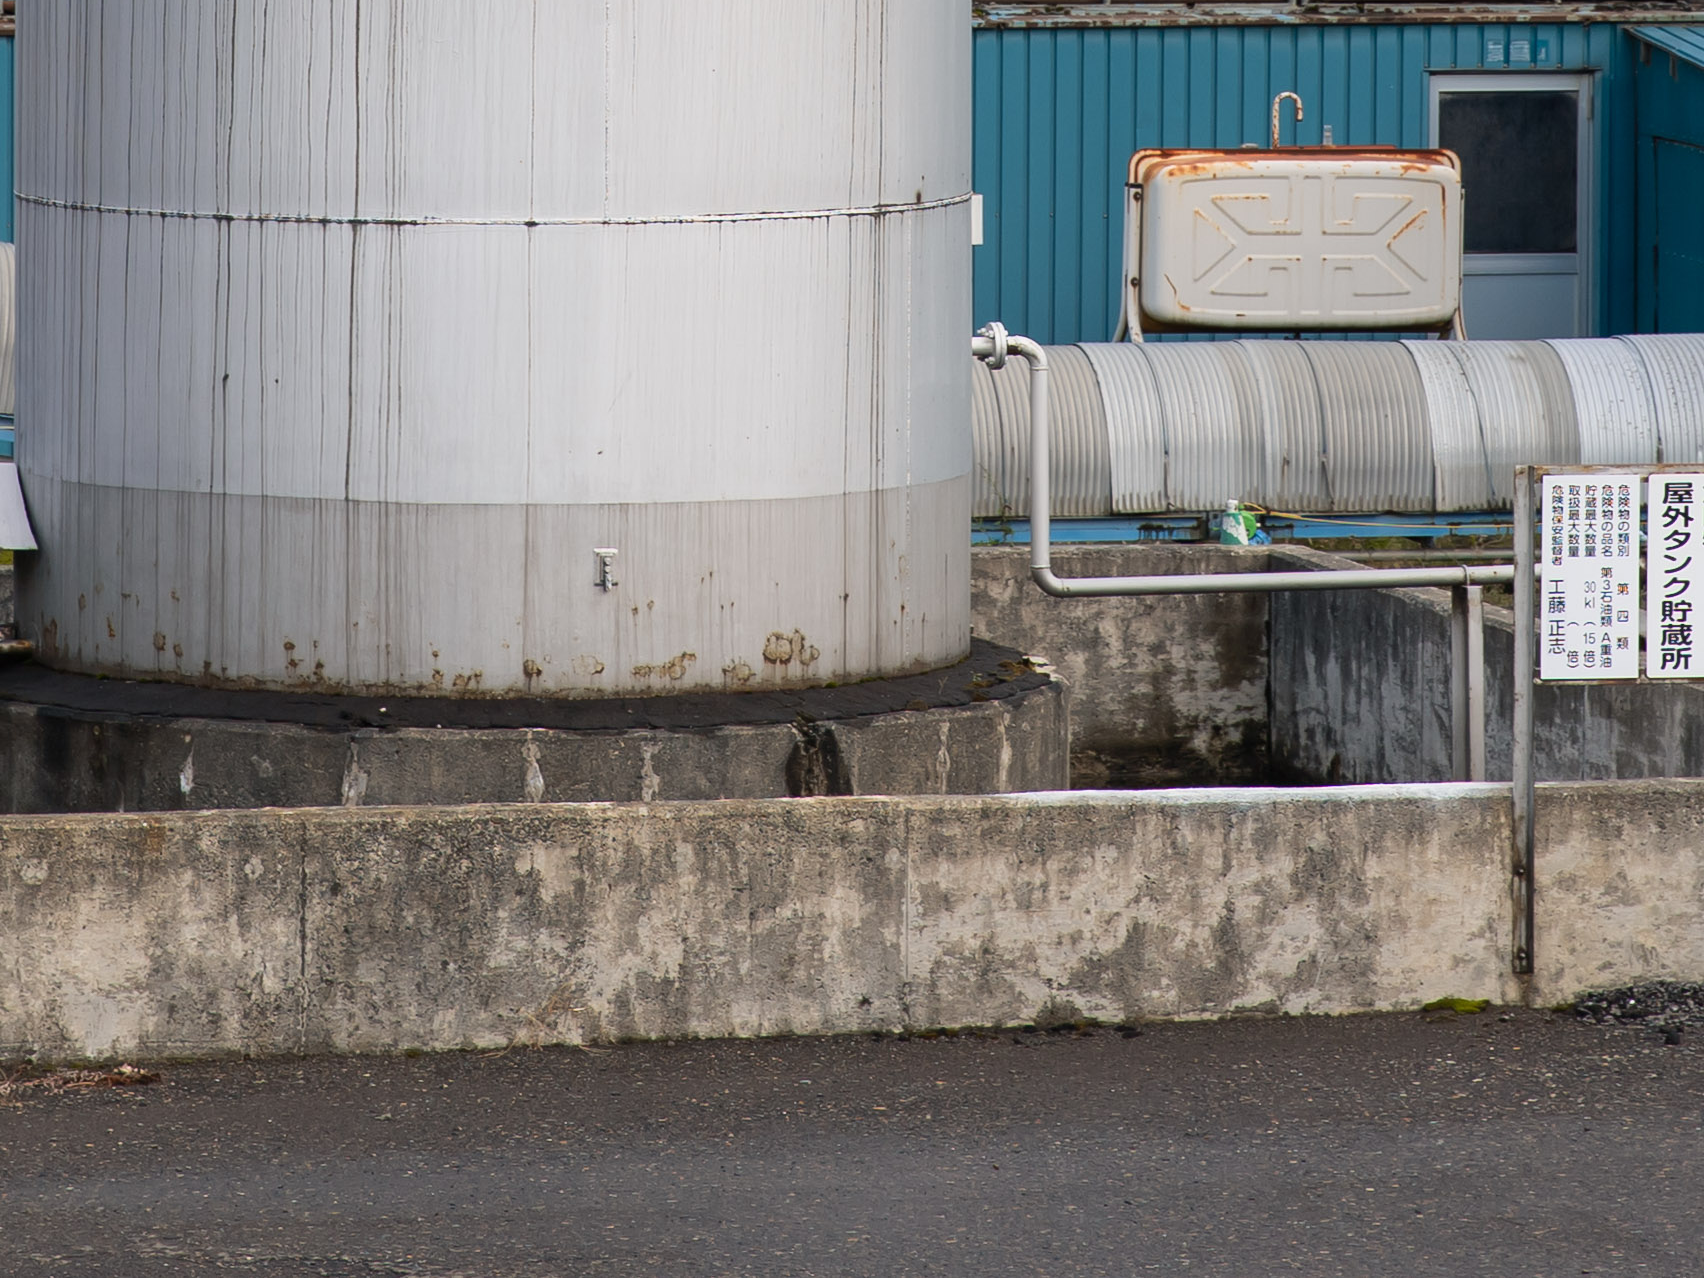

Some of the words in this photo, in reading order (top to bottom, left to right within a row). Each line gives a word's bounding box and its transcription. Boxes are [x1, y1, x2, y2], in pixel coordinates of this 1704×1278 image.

[1661, 481, 1695, 671] 屋外タンク貯蔵所
